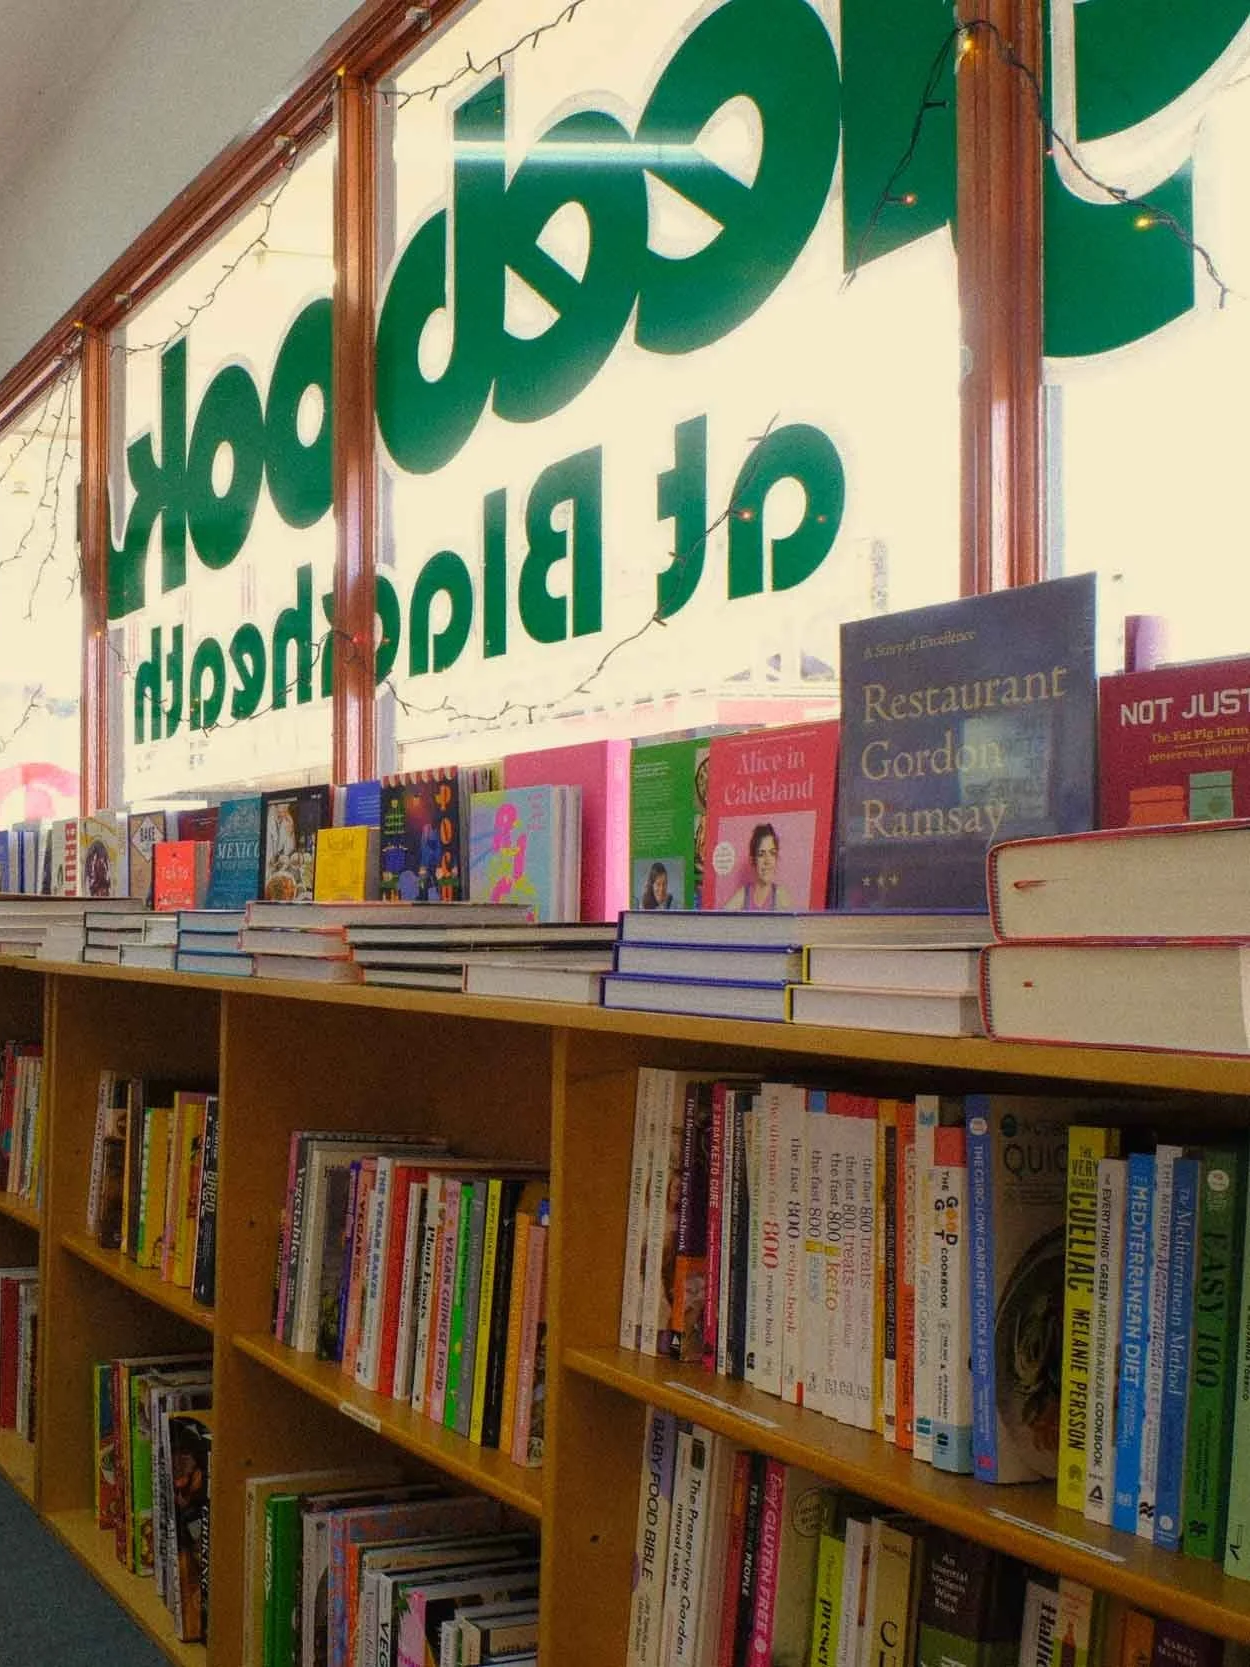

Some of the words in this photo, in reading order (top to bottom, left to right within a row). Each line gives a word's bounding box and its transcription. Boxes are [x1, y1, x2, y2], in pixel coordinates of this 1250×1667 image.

[862, 663, 1069, 723] Restaurant
[1120, 697, 1174, 727] NOT
[861, 728, 1006, 780] Gordon
[1195, 728, 1214, 742] Pig
[736, 748, 783, 776] Alice
[787, 745, 805, 770] in
[723, 774, 814, 806] Cakeland
[861, 798, 1007, 845] Ramsay
[710, 1144, 720, 1175] KETO
[789, 1138, 802, 1162] the
[811, 1149, 823, 1174] the
[829, 1152, 842, 1175] the
[846, 1155, 857, 1176] the
[862, 1158, 874, 1178] the
[974, 1144, 985, 1164] THE
[709, 1178, 719, 1209] CURE
[789, 1166, 802, 1194] fast
[810, 1175, 823, 1203] fast
[828, 1178, 842, 1206] fast
[845, 1176, 857, 1201] fast
[862, 1179, 873, 1204] fast
[940, 1170, 949, 1190] THE
[291, 1167, 306, 1264] Vegetables
[787, 1200, 801, 1240] 800
[808, 1206, 822, 1238] 800
[826, 1209, 841, 1242] 800
[842, 1203, 856, 1230] 800
[859, 1206, 873, 1233] 800
[1100, 1188, 1112, 1258] EVERYTHING
[444, 1237, 454, 1285] VEGAN
[762, 1220, 780, 1270] 800
[842, 1233, 857, 1286] treats
[859, 1235, 873, 1289] treats
[825, 1261, 842, 1311] keto
[939, 1246, 949, 1309] COOKBOOK
[976, 1271, 986, 1298] DIET
[1098, 1263, 1110, 1300] GREEN
[1171, 1206, 1192, 1327] Mediterranean
[1197, 1231, 1228, 1325] EASY
[786, 1295, 799, 1335] book
[976, 1298, 987, 1336] QUICK
[1072, 1307, 1091, 1373] MELANIE
[1095, 1302, 1109, 1399] MEDITERRANEAN
[1195, 1329, 1224, 1389] 100
[977, 1347, 988, 1377] EASY
[1123, 1343, 1141, 1387] DIET
[1167, 1331, 1185, 1395] Method
[1069, 1379, 1090, 1450] PERSSON
[1093, 1401, 1106, 1466] COOKBOOK
[652, 1418, 665, 1471] BABY
[645, 1471, 661, 1526] FOOD
[689, 1478, 701, 1504] The
[749, 1483, 759, 1505] TEA
[673, 1503, 685, 1549] natural
[759, 1509, 776, 1583] GLUTEN
[641, 1528, 657, 1581] BIBLE
[680, 1508, 699, 1591] Preserving
[669, 1552, 682, 1588] cakes
[741, 1551, 754, 1597] PEOPLE
[675, 1595, 690, 1657] Garden
[754, 1584, 771, 1636] FREE
